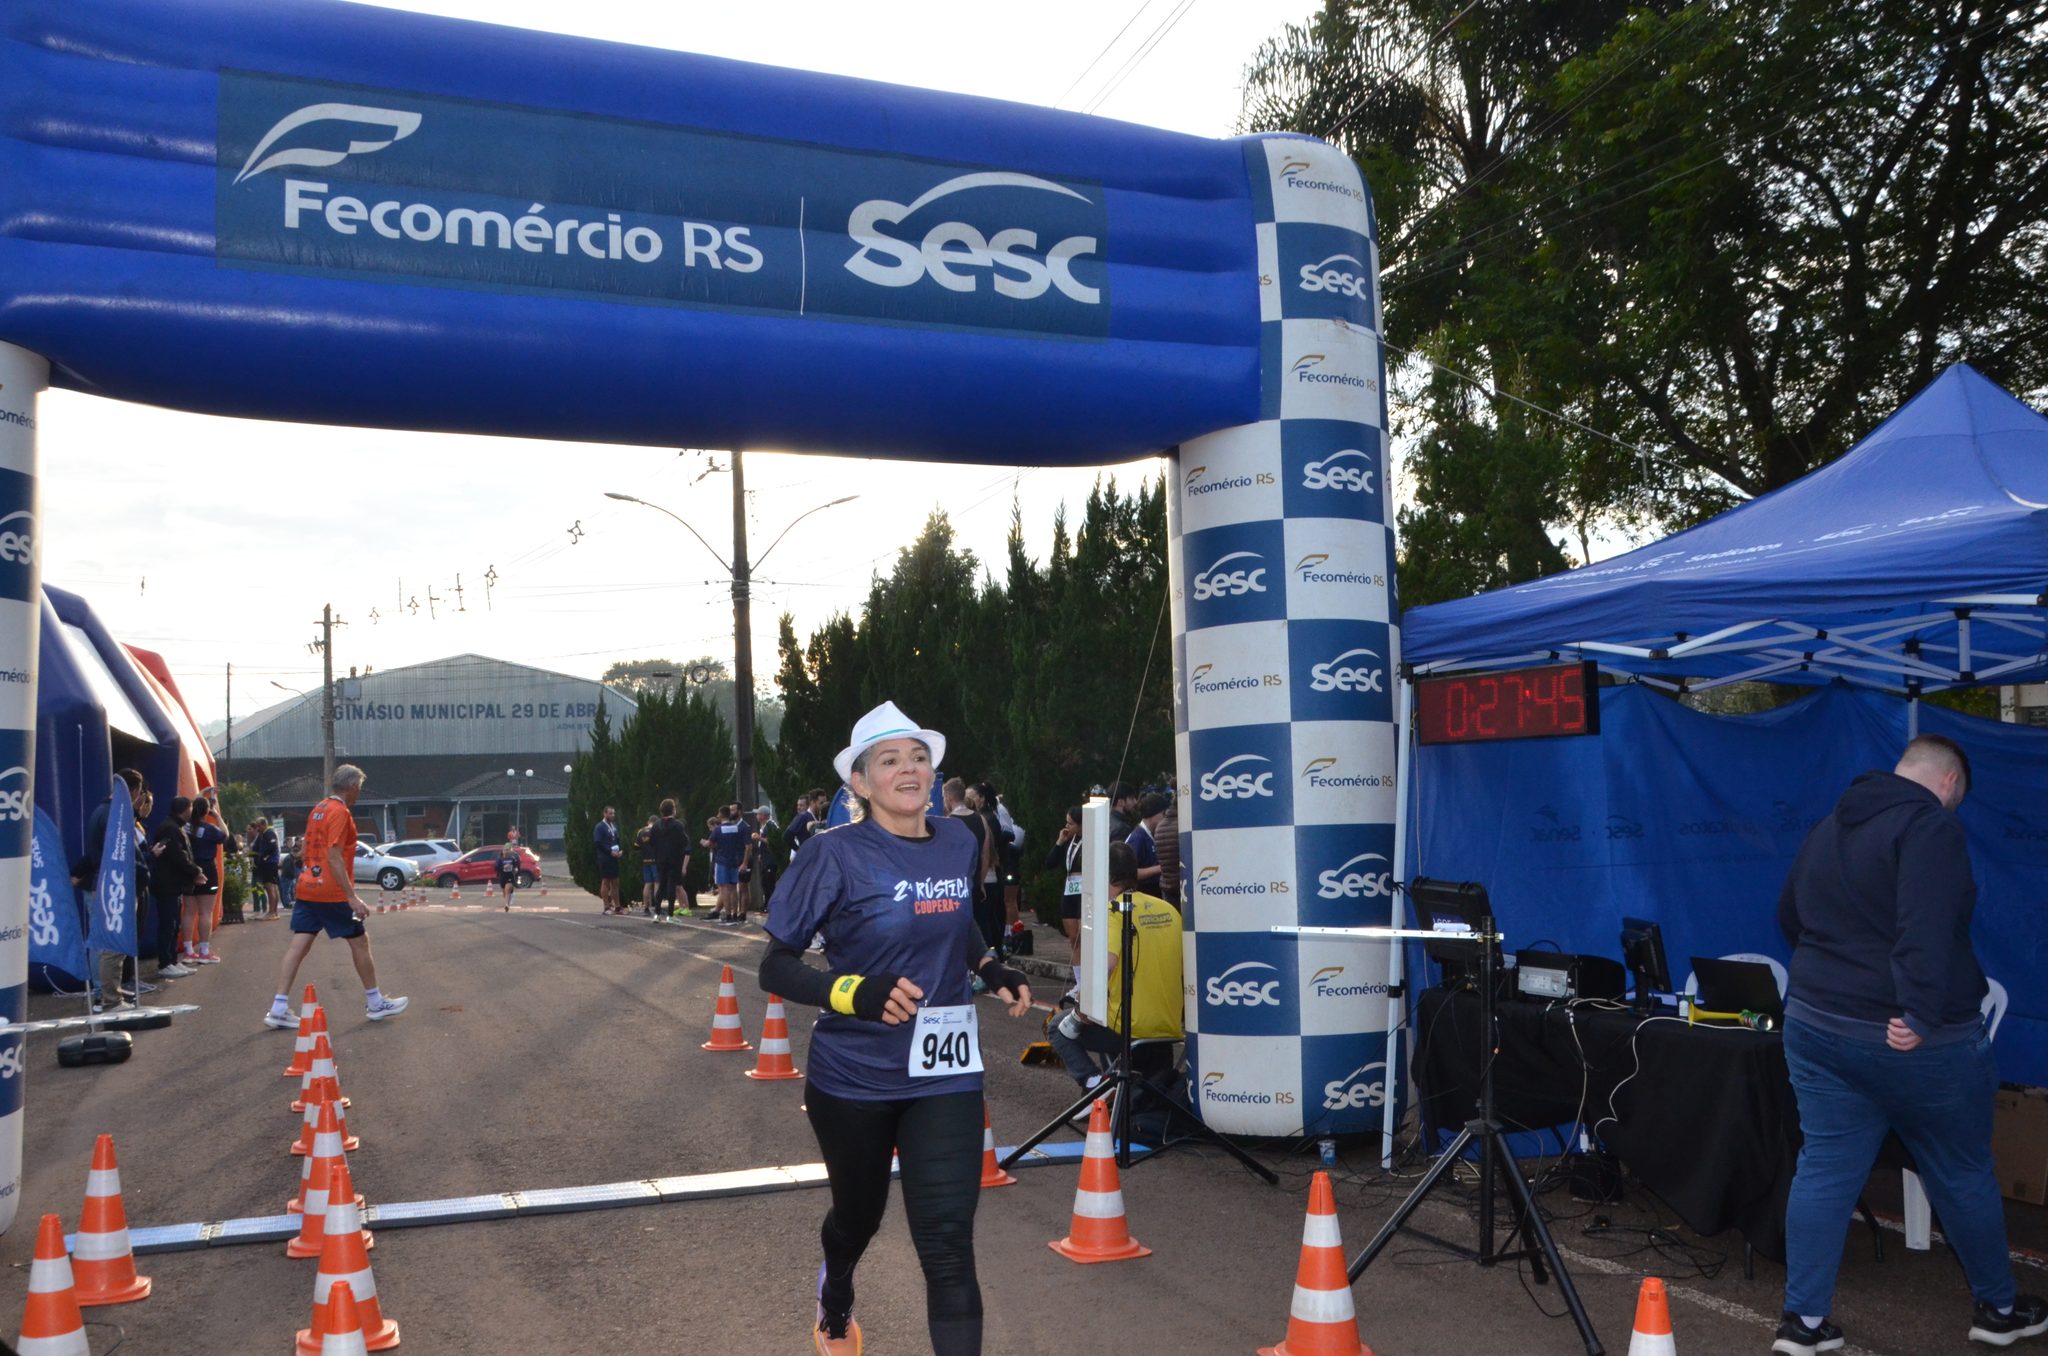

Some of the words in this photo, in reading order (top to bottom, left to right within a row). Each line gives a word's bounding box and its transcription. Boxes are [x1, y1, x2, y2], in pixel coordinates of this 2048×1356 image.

[1287, 177, 1351, 197] Fecomércio
[1352, 189, 1363, 202] RS
[285, 178, 663, 264] Fecomércio
[683, 221, 764, 273] RS
[844, 172, 1100, 304] Sesc
[1300, 254, 1367, 300] Sesc
[1299, 370, 1365, 388] Fecomércio
[1366, 378, 1377, 392] RS
[1187, 474, 1252, 497] Fecomércio
[1256, 472, 1275, 485] RS
[1302, 449, 1374, 494] Sesc
[1193, 551, 1267, 601] Sesc
[1303, 570, 1371, 585] Fecomércio
[1373, 575, 1384, 587] RS
[1194, 676, 1259, 694] Fecomércio
[1263, 674, 1282, 687] RS
[1309, 648, 1383, 694] Sesc
[334, 701, 405, 721] GINÁSIO
[411, 703, 506, 719] MUNICIPAL
[512, 703, 534, 719] 29
[539, 703, 560, 718] DE
[565, 703, 612, 719] ABRL
[1446, 668, 1585, 737] 0:27:45
[1200, 754, 1274, 801] Sesc
[1311, 774, 1380, 788] Fecomércio
[1381, 775, 1393, 788] RS
[1201, 881, 1266, 895] Fecomércio
[1270, 881, 1289, 894] RS
[1317, 853, 1392, 899] Sesc
[101, 870, 126, 933] Sesc
[1206, 962, 1280, 1007] Sesc
[1317, 982, 1388, 997] Fecomércio
[922, 1031, 970, 1070] 940
[1206, 1090, 1271, 1105] Fecomércio
[1275, 1091, 1295, 1105] RS
